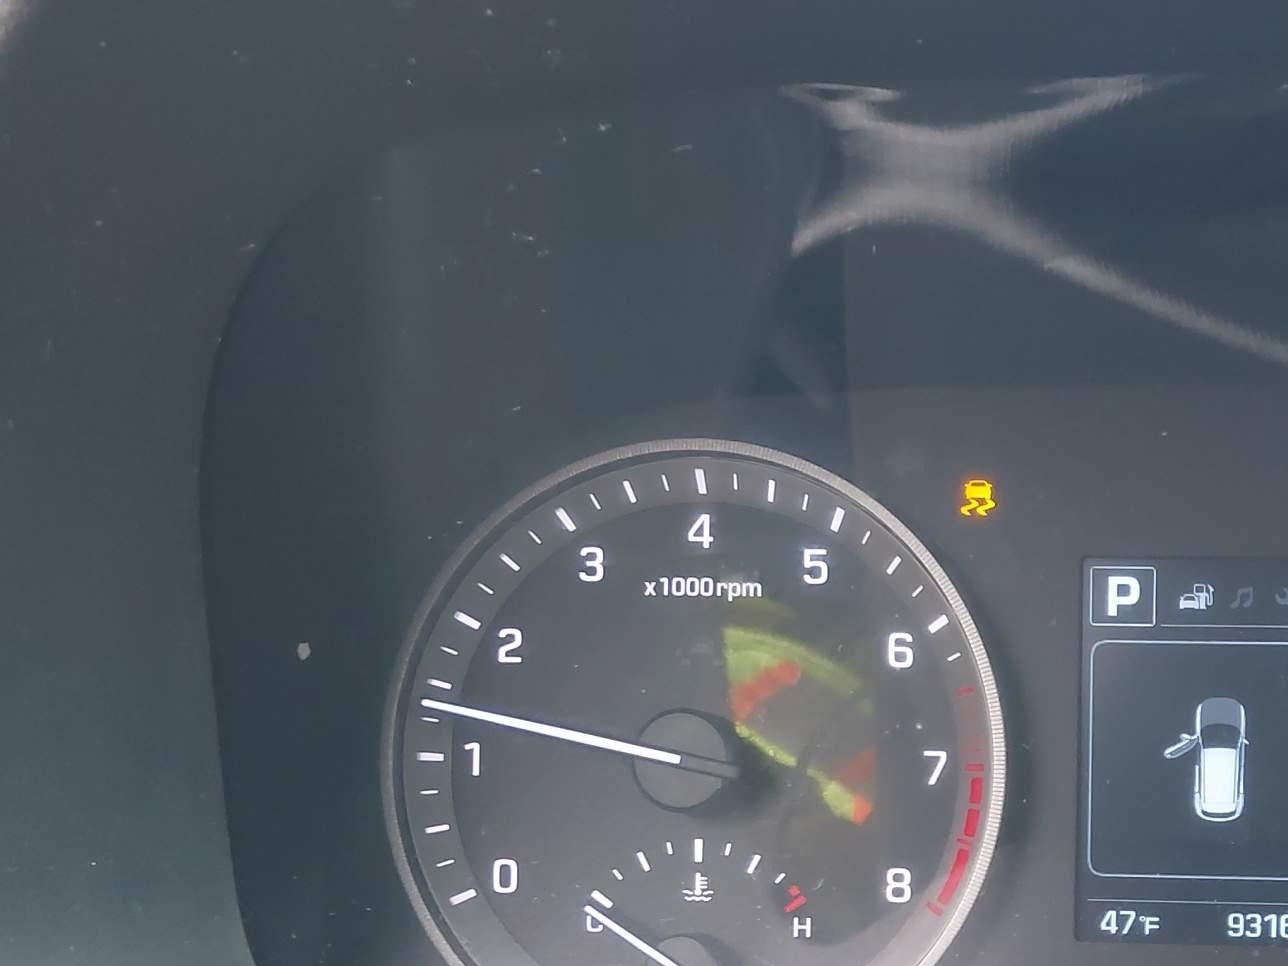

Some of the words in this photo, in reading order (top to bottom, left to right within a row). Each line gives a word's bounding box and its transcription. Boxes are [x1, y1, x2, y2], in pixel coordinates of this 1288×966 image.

[687, 513, 714, 549] 4
[578, 546, 604, 582] 3
[802, 547, 828, 585] 5
[1106, 575, 1141, 617] P
[497, 628, 523, 663] 2
[887, 632, 914, 669] 6
[463, 742, 481, 777] 1
[922, 750, 948, 786] 7
[492, 858, 518, 894] 0
[884, 867, 912, 904] 8
[792, 916, 812, 938] H
